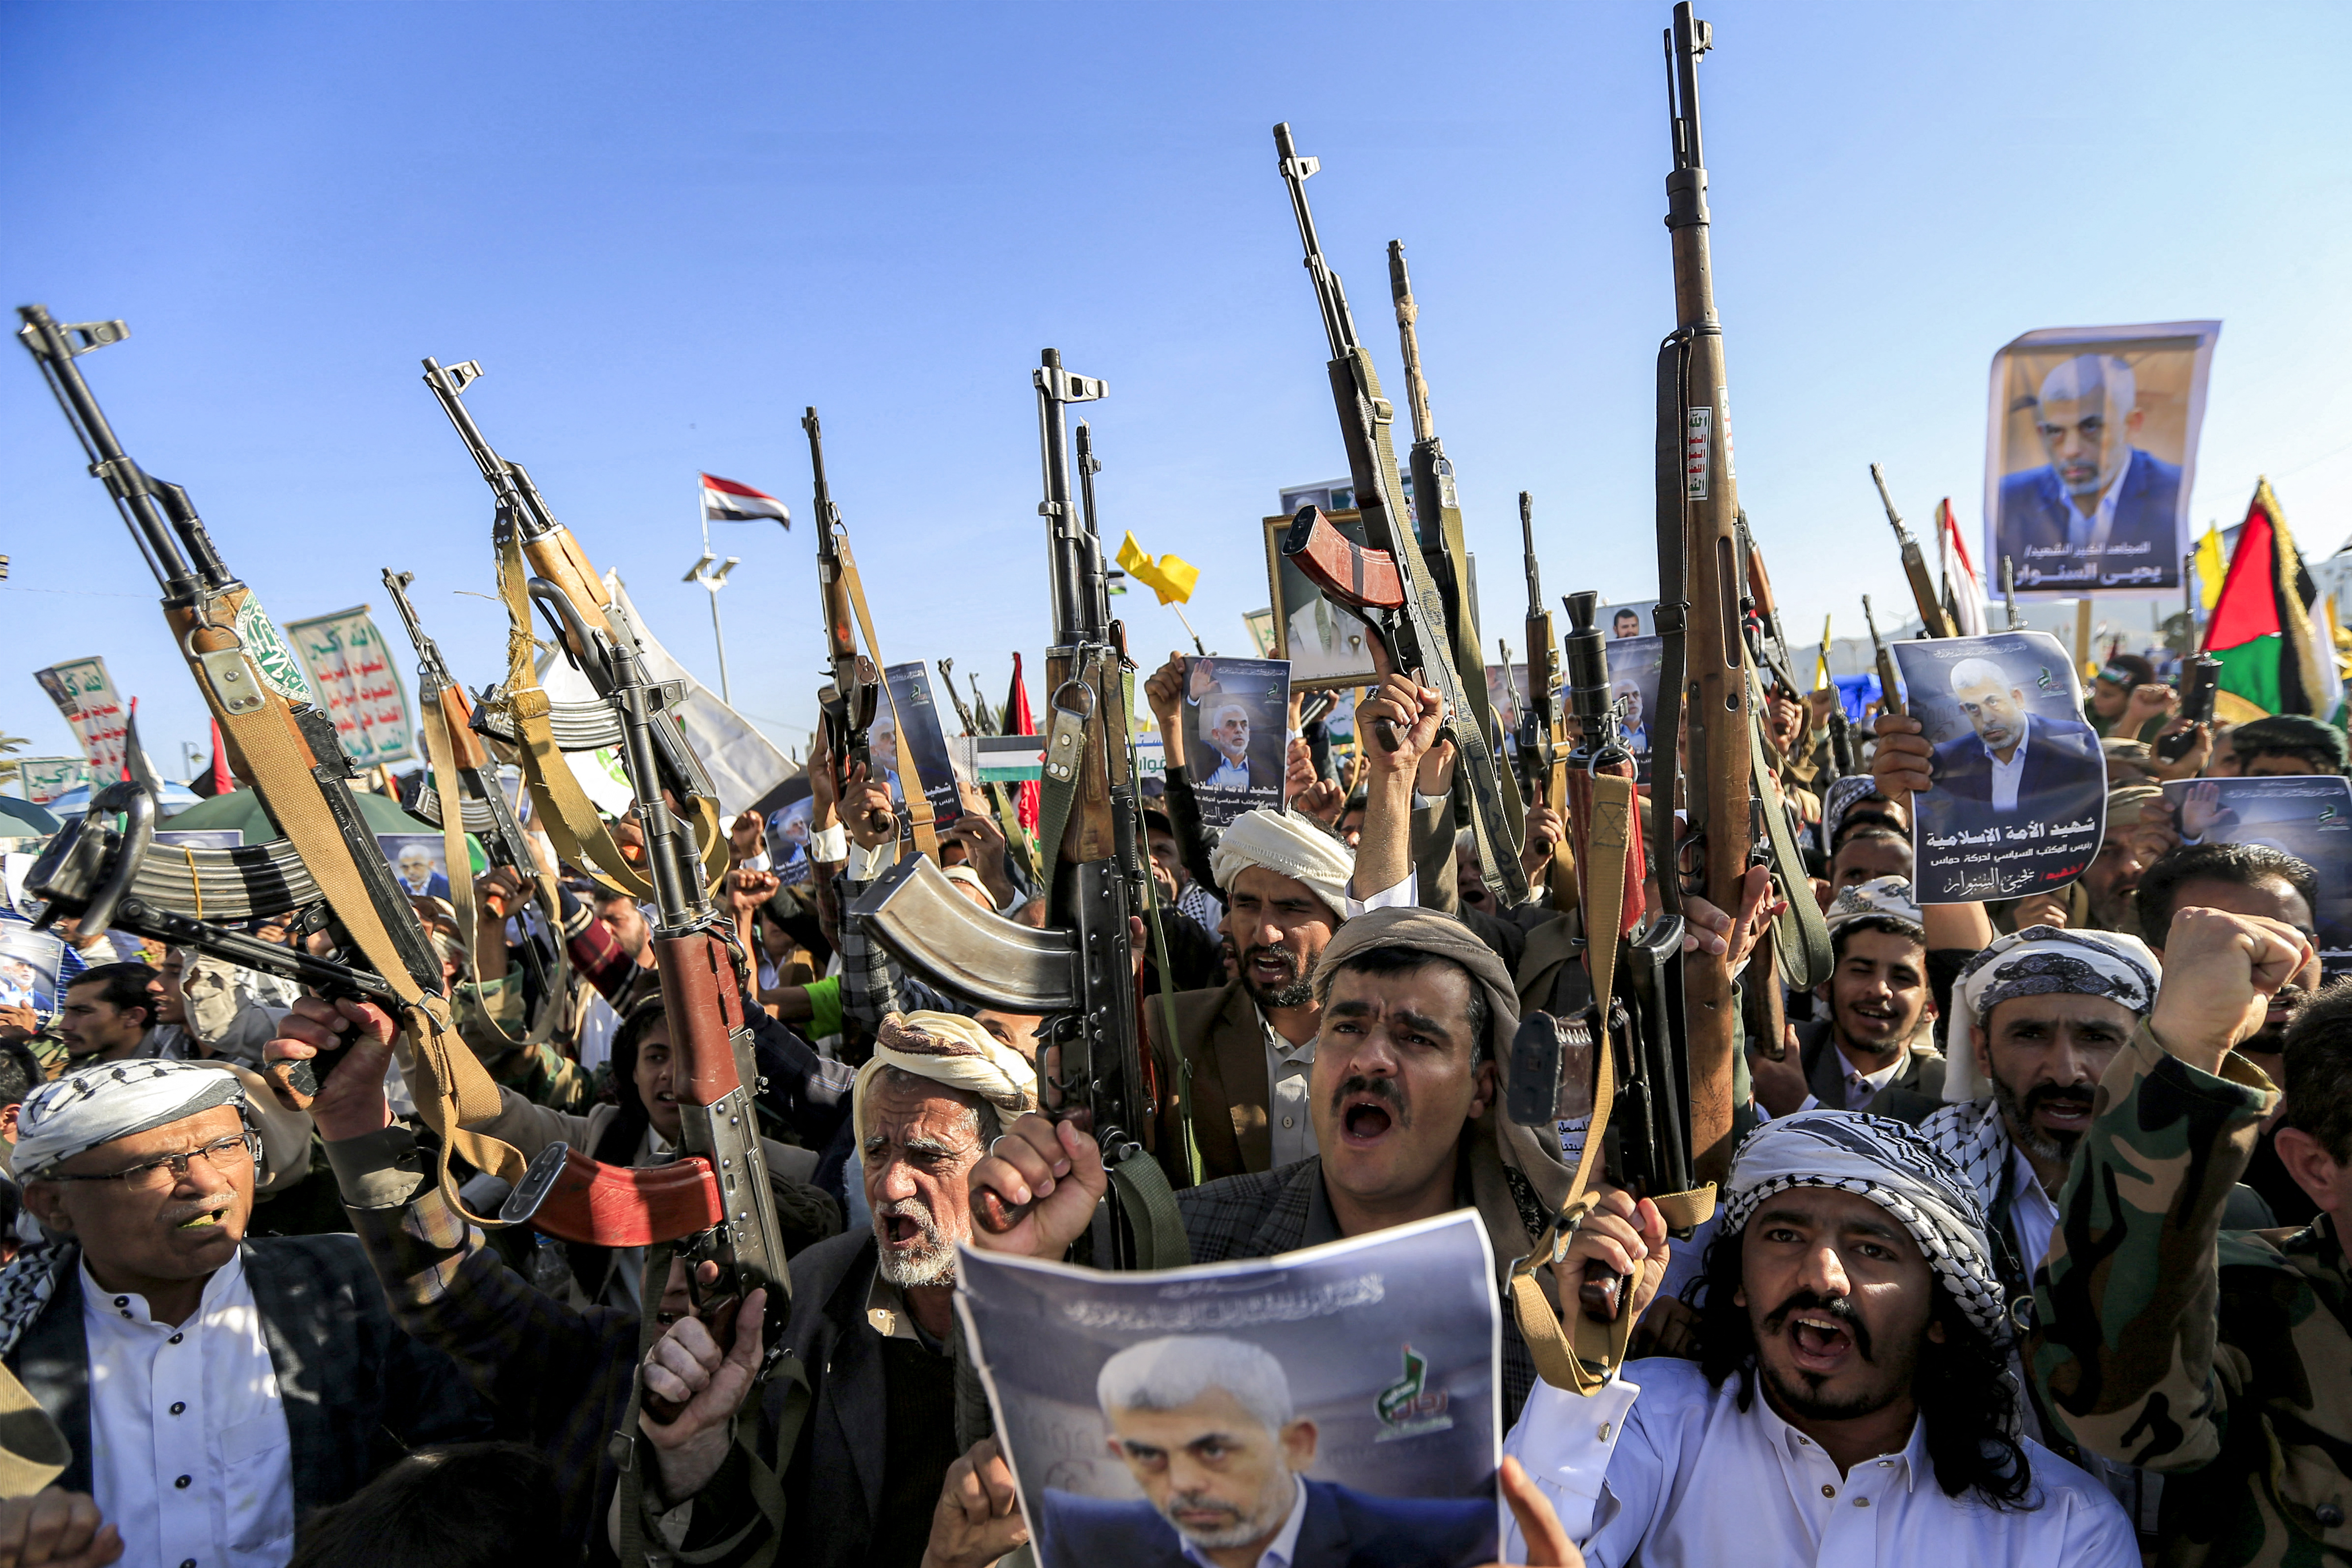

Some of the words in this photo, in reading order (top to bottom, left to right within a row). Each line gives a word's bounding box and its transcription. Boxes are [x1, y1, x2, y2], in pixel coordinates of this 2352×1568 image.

[1689, 434, 1706, 446] المو
[1689, 449, 1705, 461] المو
[1689, 464, 1705, 474] اللعن
[1249, 785, 1279, 796] شهيد
[2005, 820, 2045, 840] الأمة
[2049, 817, 2096, 838] شهيد
[1926, 827, 2002, 850] الإسلامية
[2036, 843, 2067, 856] المكتب
[2069, 841, 2093, 853] رئيس
[1930, 856, 1960, 866] حماس
[1963, 852, 1991, 863] لحركة
[1993, 848, 2033, 863] السياسي
